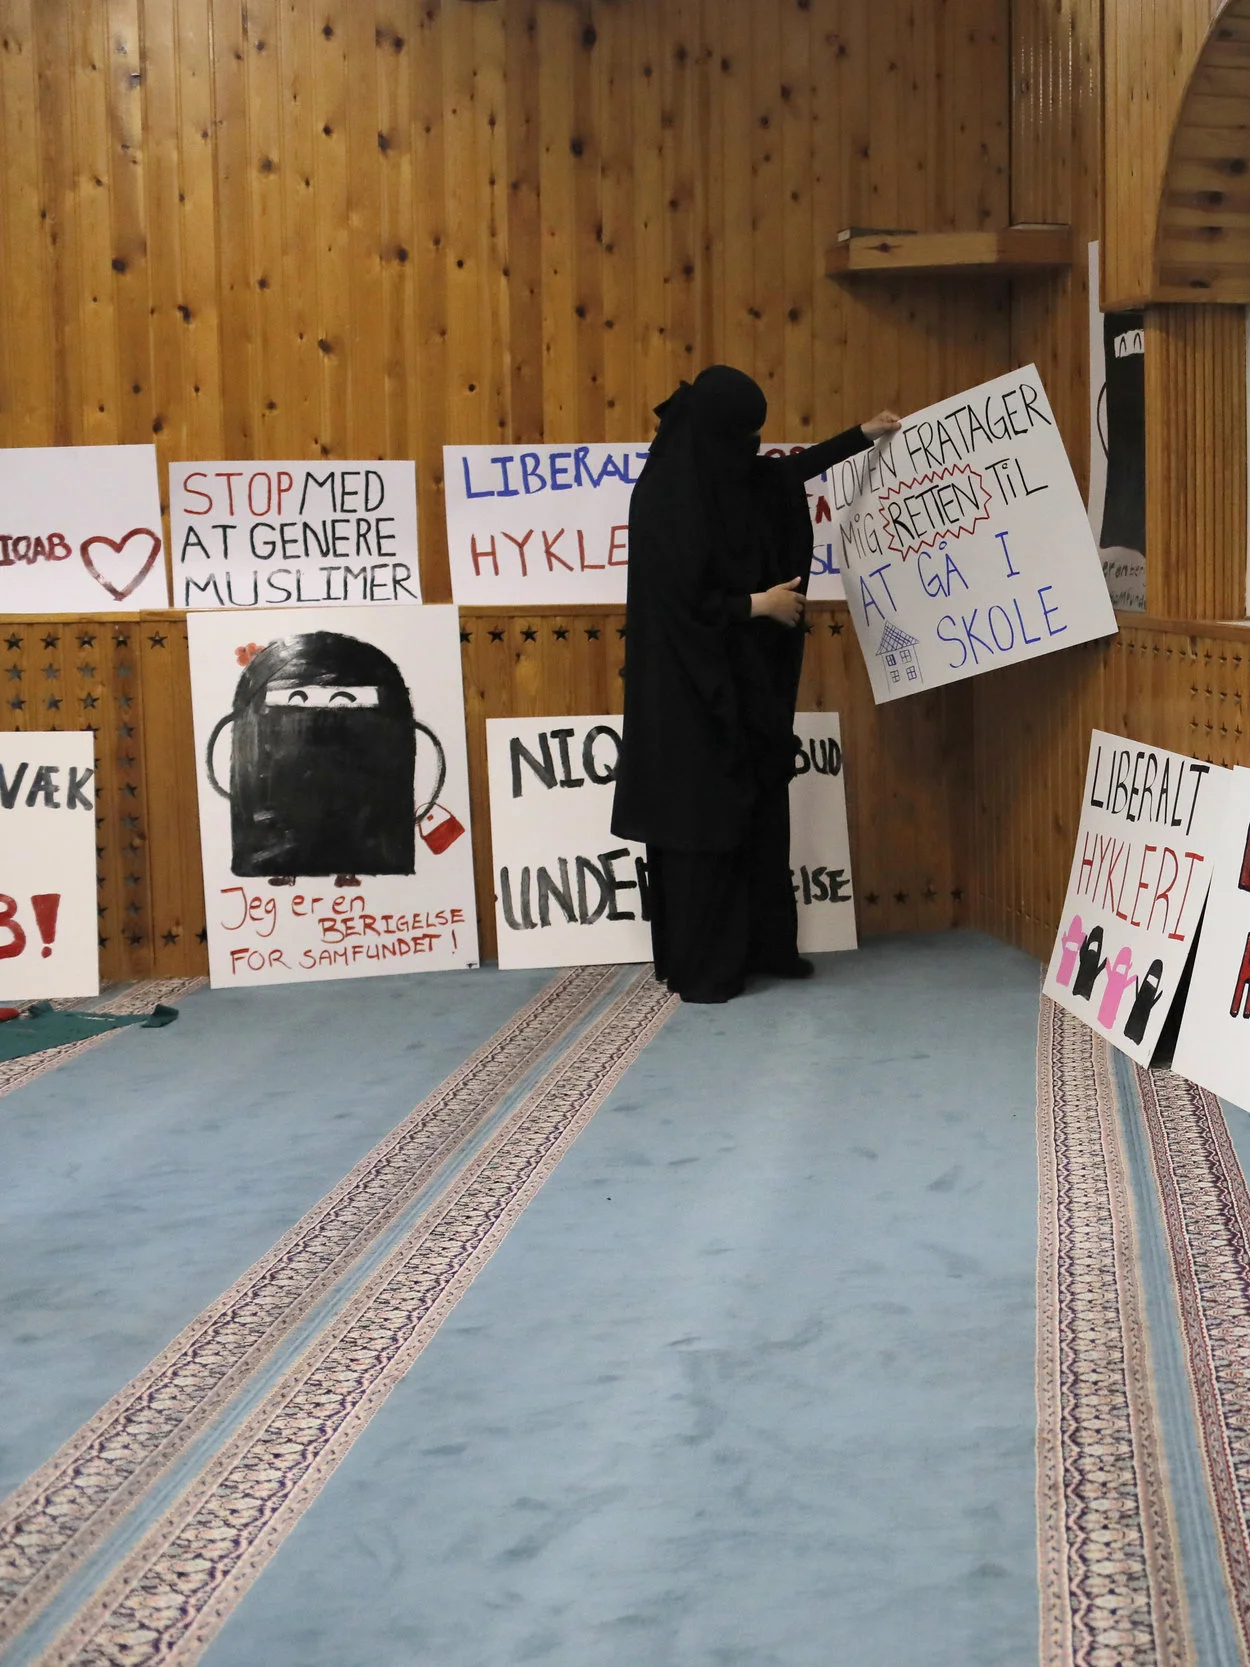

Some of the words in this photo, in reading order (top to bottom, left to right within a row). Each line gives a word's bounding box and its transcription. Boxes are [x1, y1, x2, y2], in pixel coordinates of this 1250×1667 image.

[830, 442, 897, 510] LOVEN
[902, 383, 1052, 473] FRATAGER
[183, 472, 293, 516] STOP
[299, 470, 385, 516] MED
[887, 476, 980, 548] RETTEN
[181, 525, 237, 563] AT
[250, 518, 397, 560] GENERE
[184, 563, 419, 607] MUSLIMER
[859, 564, 897, 627] AT
[917, 541, 969, 598] GÅ
[995, 531, 1020, 578] I
[936, 585, 1068, 668] SKOLE
[0, 762, 94, 811] VÆK
[1090, 745, 1211, 837] LIBERALT
[220, 886, 277, 938] Jeg
[291, 894, 324, 917] er
[332, 895, 365, 914] en
[1076, 831, 1204, 942] HYKLERI
[318, 909, 465, 944] BERIGELSE
[230, 947, 292, 975] FOR
[298, 933, 442, 969] SAMFUNDET
